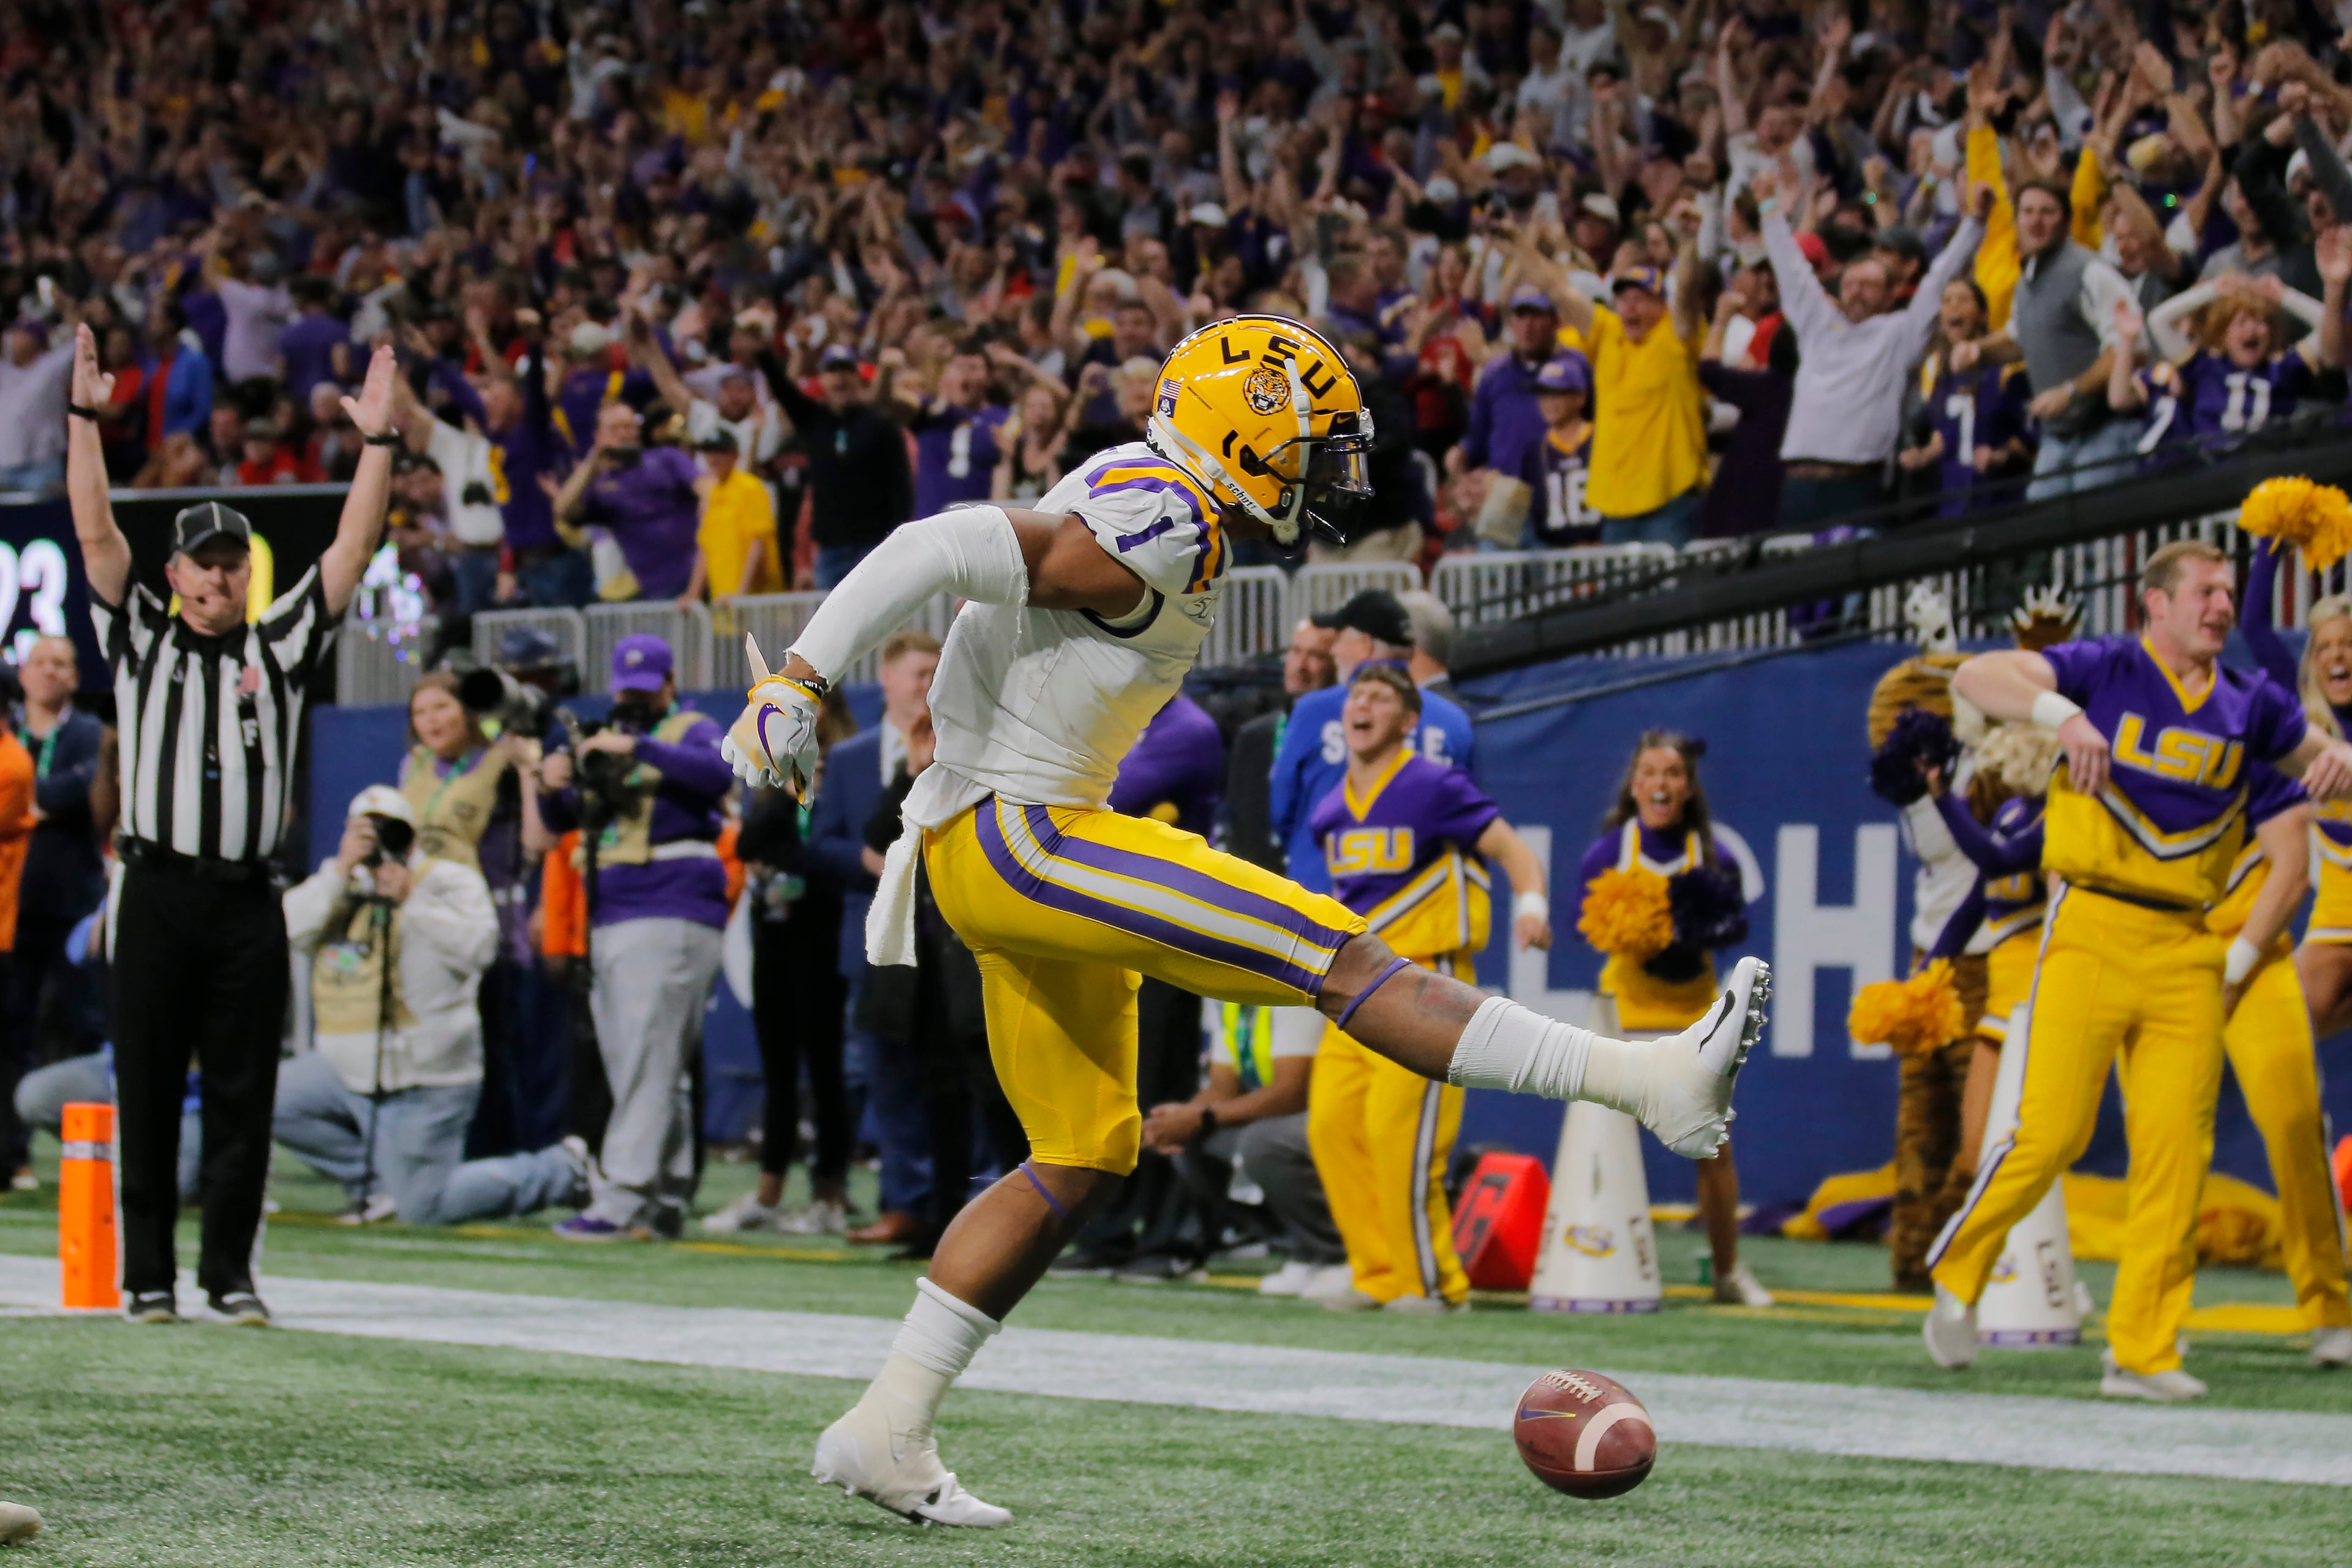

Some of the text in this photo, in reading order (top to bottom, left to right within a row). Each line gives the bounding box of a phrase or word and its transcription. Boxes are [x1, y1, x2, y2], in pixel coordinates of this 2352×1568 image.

[1221, 335, 1338, 400] LSU
[1947, 394, 1975, 466] 7
[2220, 372, 2270, 432] 11
[1115, 516, 1175, 553] 1
[2113, 711, 2244, 789] LSU
[1324, 824, 1415, 878] LSU
